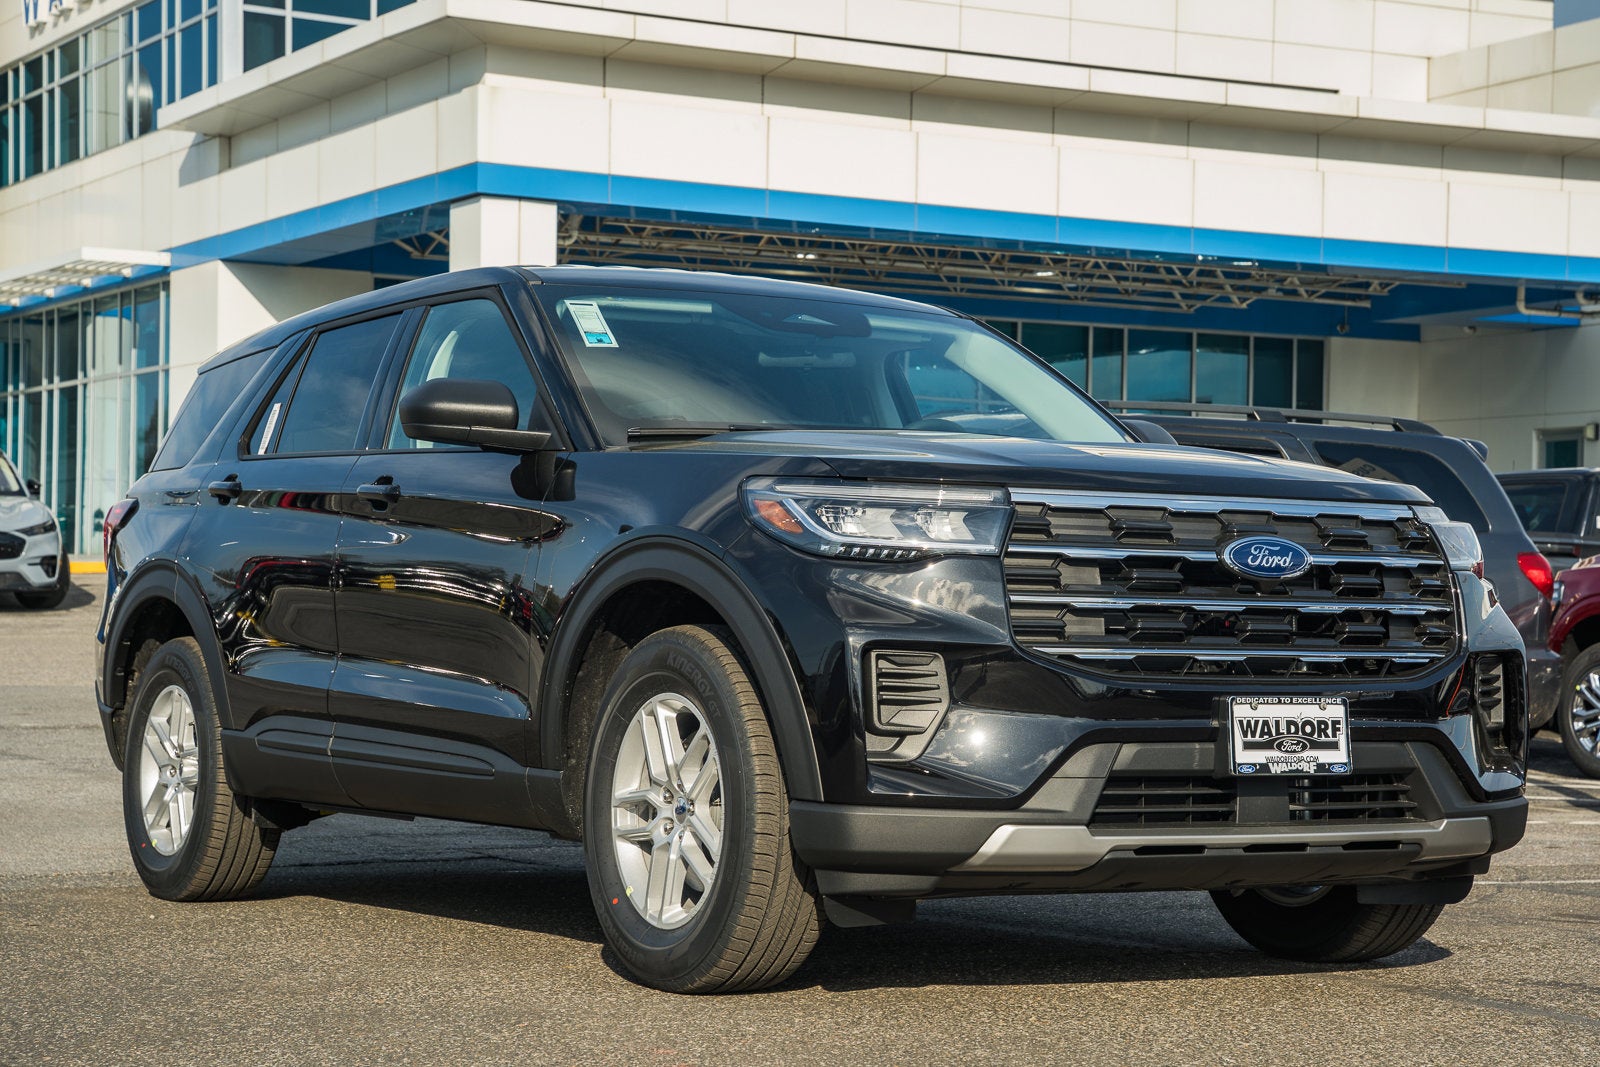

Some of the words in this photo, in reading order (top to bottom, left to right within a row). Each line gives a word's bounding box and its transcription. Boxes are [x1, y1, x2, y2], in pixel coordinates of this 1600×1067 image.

[1248, 544, 1293, 568] Ford
[1236, 696, 1279, 704] DEDICATED
[1280, 696, 1291, 704] TO
[1292, 697, 1342, 705] EXCELLENCE
[1236, 718, 1343, 740] WALDORF
[1281, 740, 1303, 752] Ford
[1268, 762, 1317, 774] WALDORF
